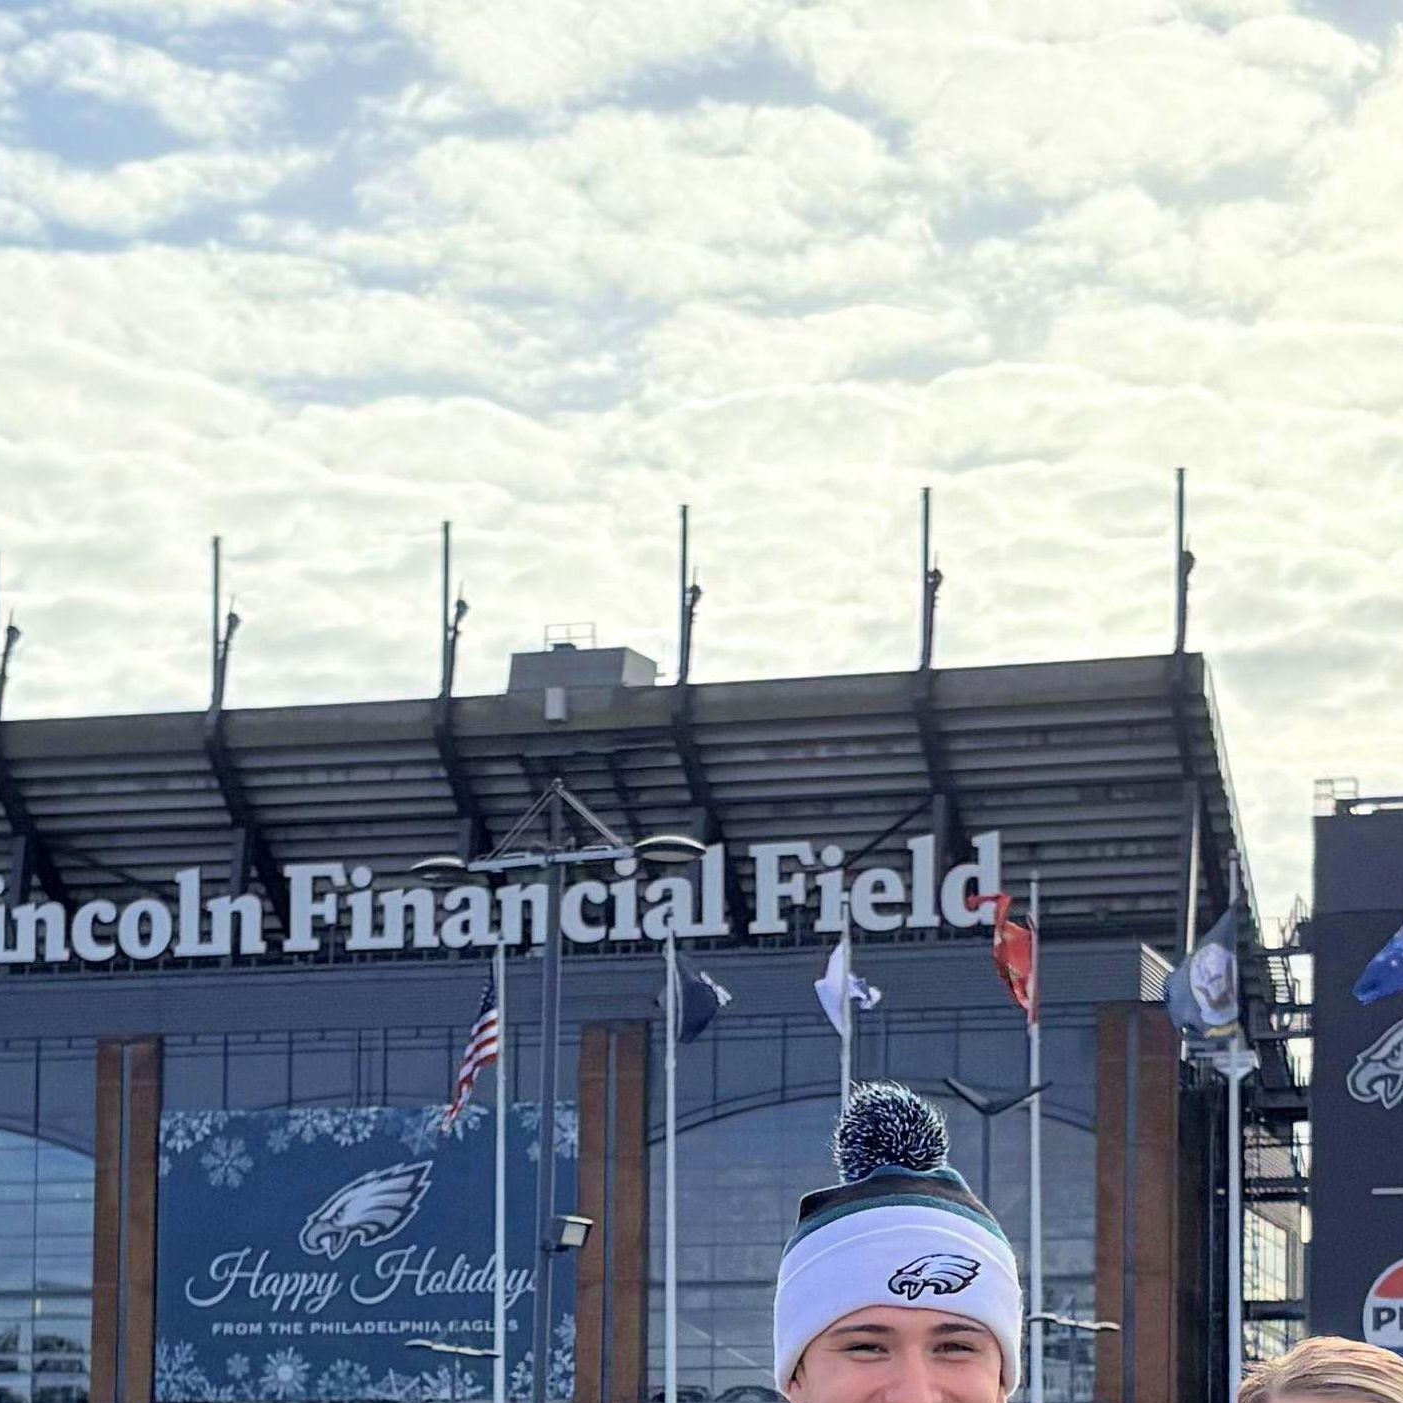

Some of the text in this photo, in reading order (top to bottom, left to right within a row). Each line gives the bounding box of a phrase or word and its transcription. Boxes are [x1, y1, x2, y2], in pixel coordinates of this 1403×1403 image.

[282, 843, 731, 954] Financial
[747, 830, 1002, 936] Field
[185, 1246, 344, 1314] Happy
[211, 1318, 519, 1336] FROM THE PHILADELPHIA EAGLS
